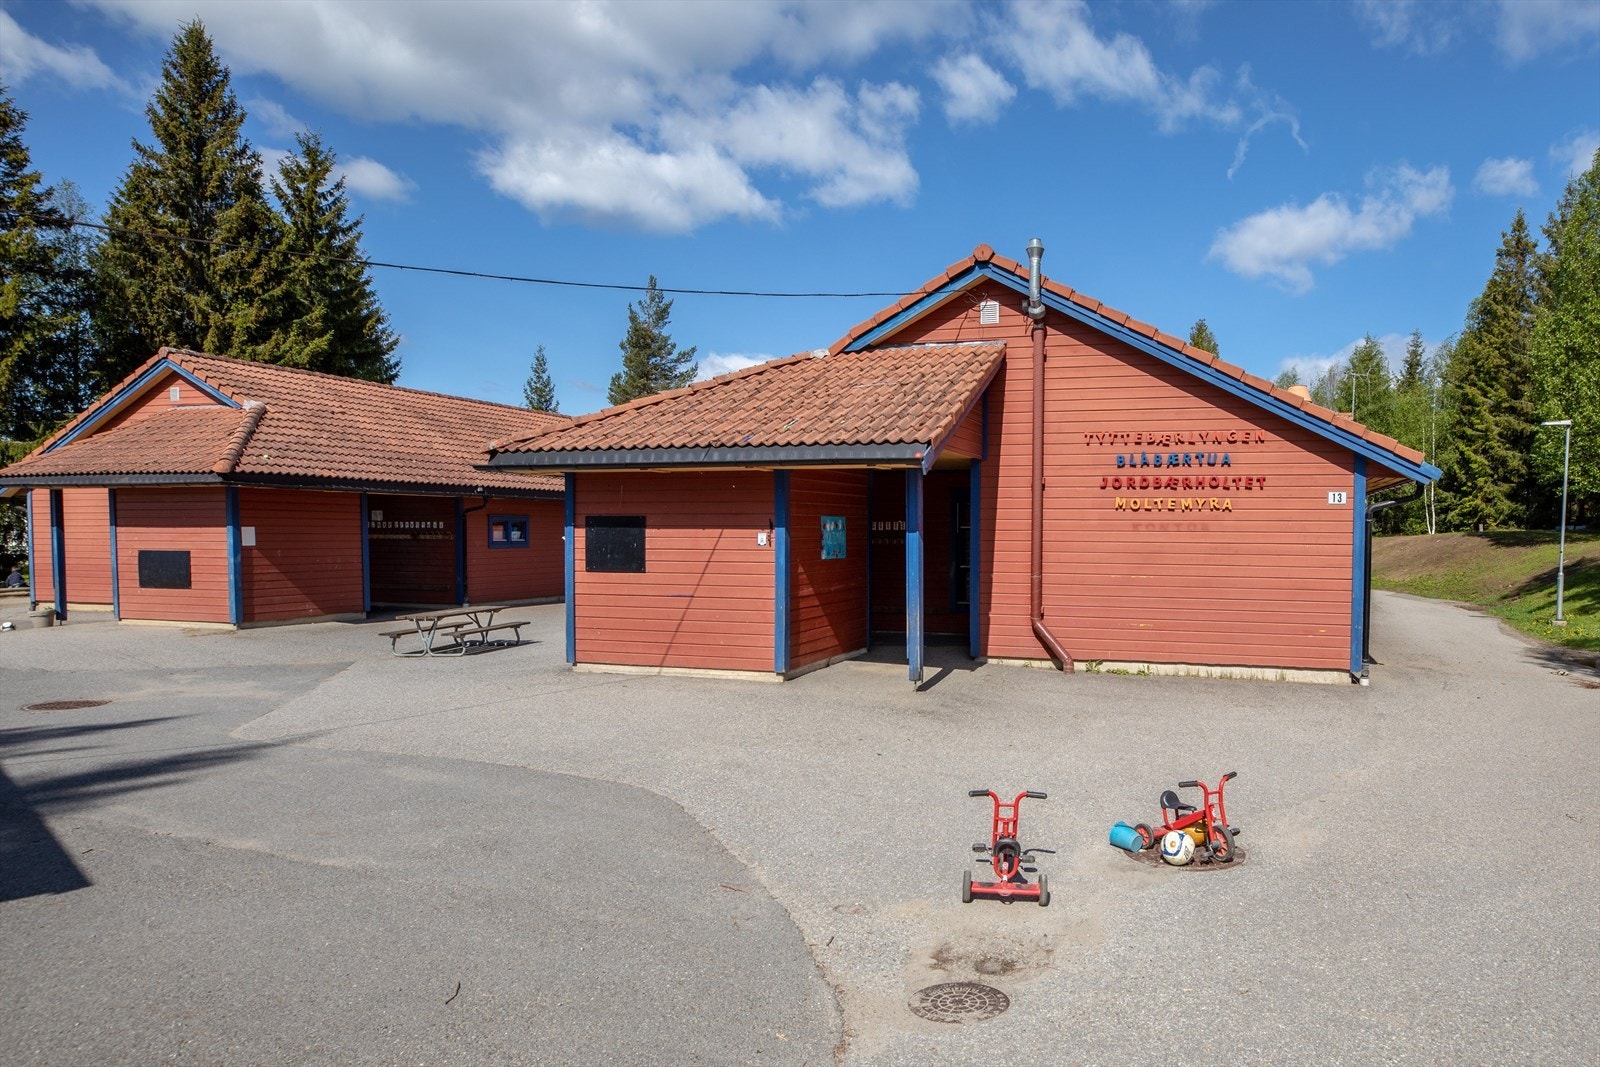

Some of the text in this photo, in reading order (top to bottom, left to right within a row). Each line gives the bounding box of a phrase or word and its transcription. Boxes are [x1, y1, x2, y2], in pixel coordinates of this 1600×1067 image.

[1084, 431, 1265, 446] TYTTEBÆRLYNGEN
[1100, 476, 1266, 490] JORDBÆRHOLTET
[1114, 497, 1233, 512] MOLTEMYRA
[1332, 492, 1343, 503] 13
